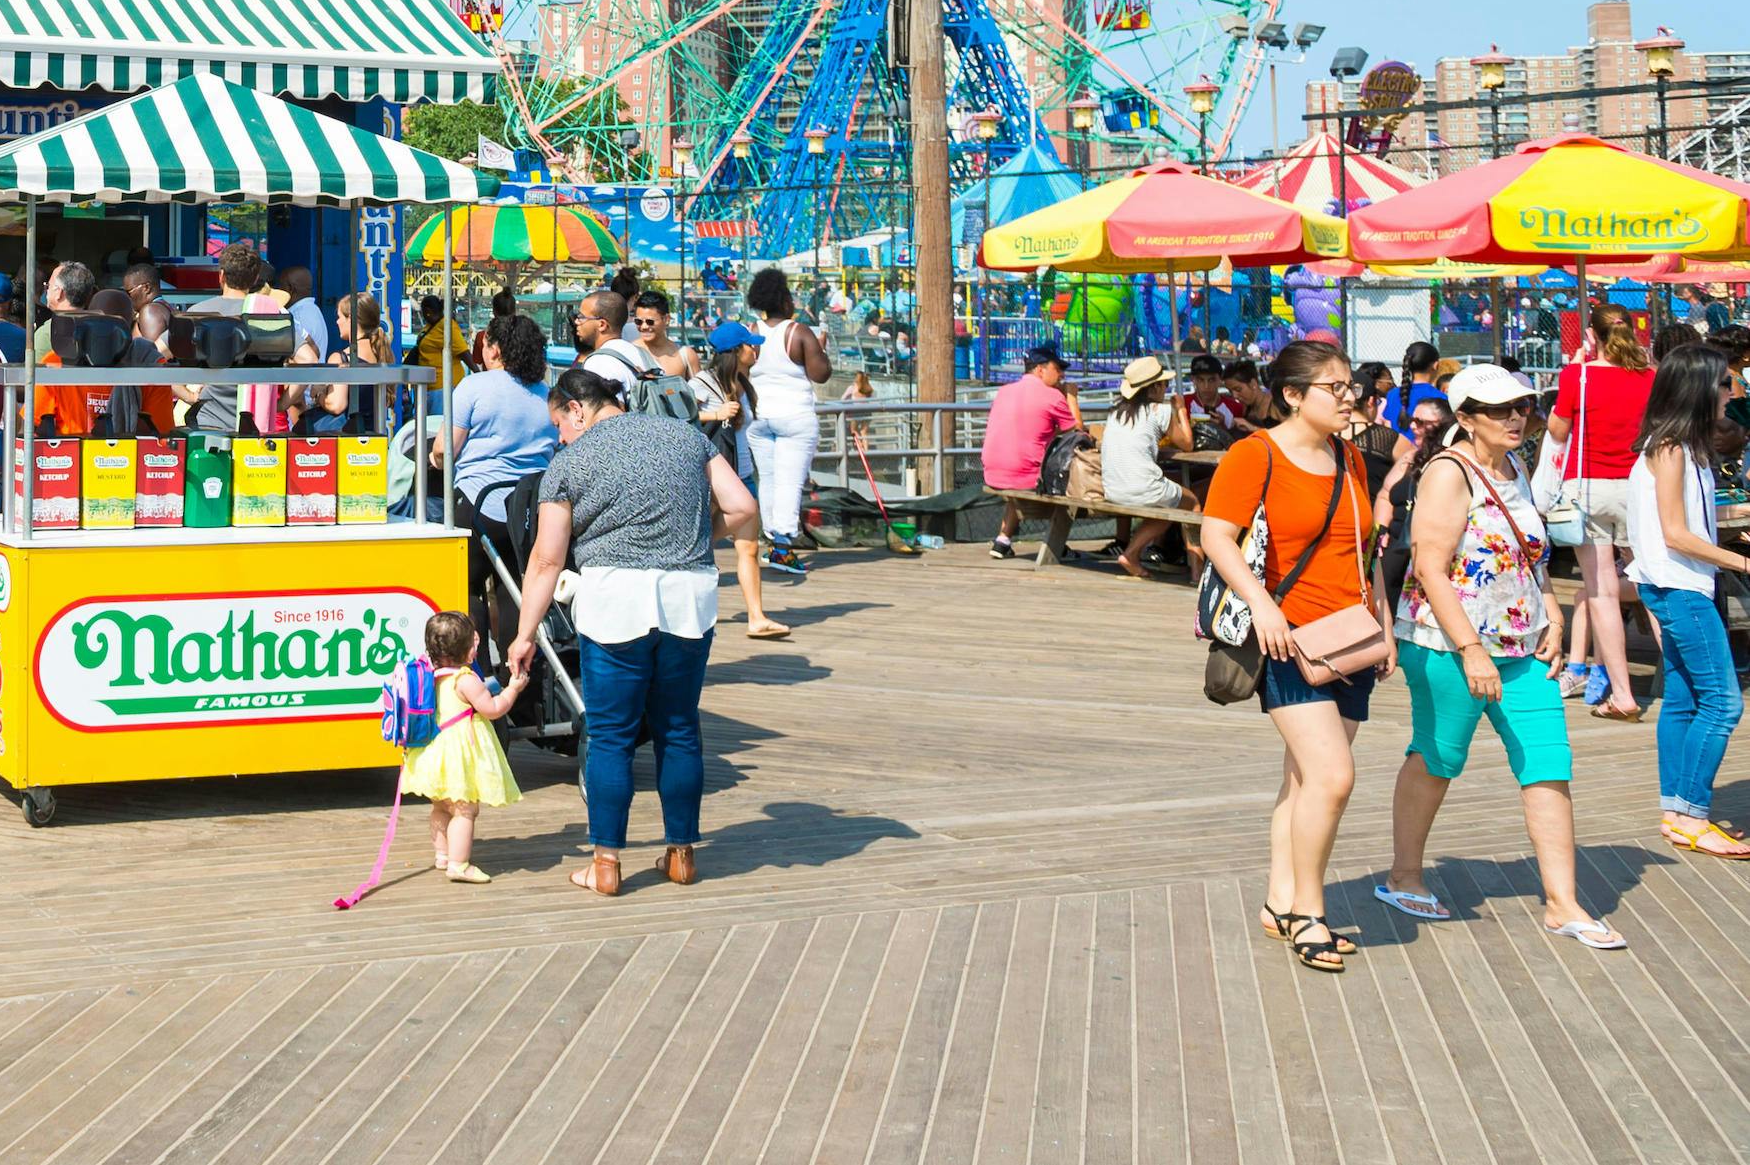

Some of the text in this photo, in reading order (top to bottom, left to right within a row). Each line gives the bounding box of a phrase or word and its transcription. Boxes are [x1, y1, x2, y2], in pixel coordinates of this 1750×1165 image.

[1520, 207, 1702, 238] Nathan's
[1186, 234, 1227, 245] TRADITION
[273, 609, 344, 624] Since 1916
[71, 607, 410, 688] Nathan's
[194, 692, 307, 710] FAMOUS
